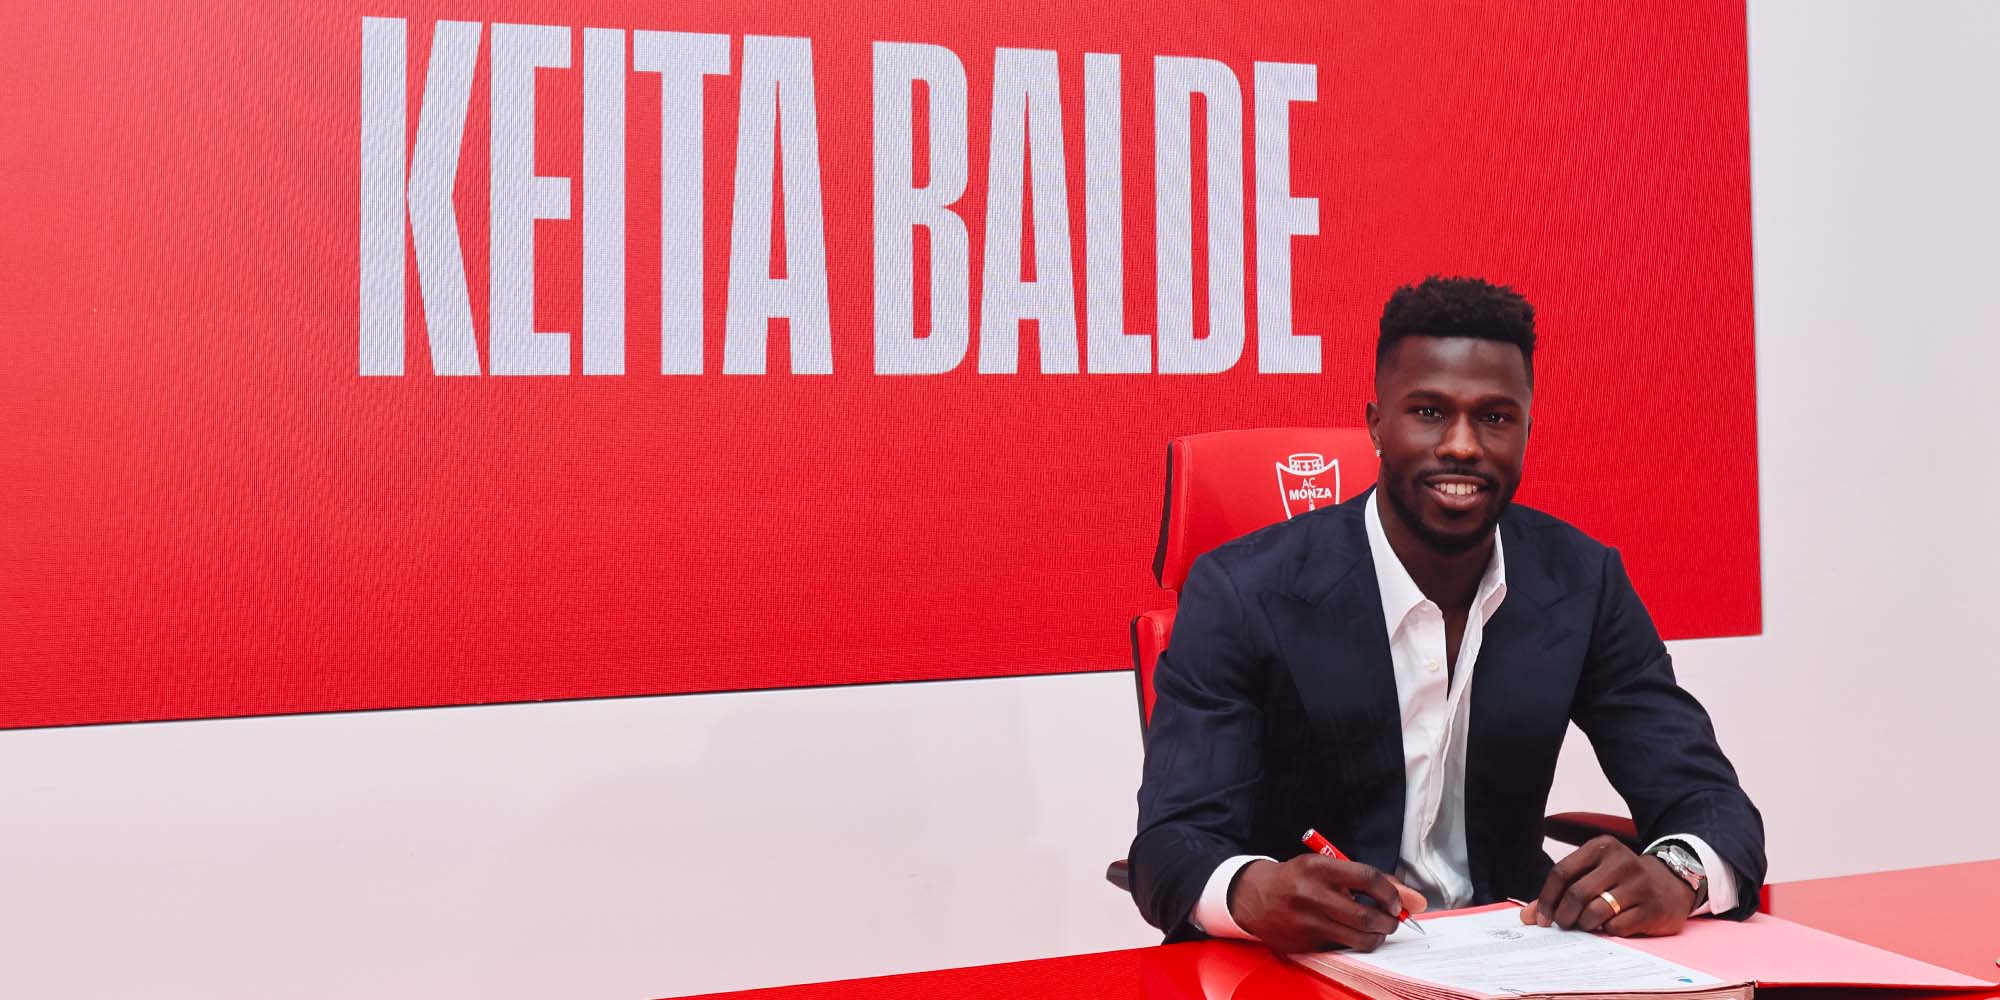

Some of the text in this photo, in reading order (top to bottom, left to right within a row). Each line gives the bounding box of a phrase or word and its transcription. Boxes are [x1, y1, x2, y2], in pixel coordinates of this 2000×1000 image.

[359, 16, 1322, 377] KEITA BALDE
[1302, 477, 1317, 488] AC
[1289, 488, 1332, 501] MONZA
